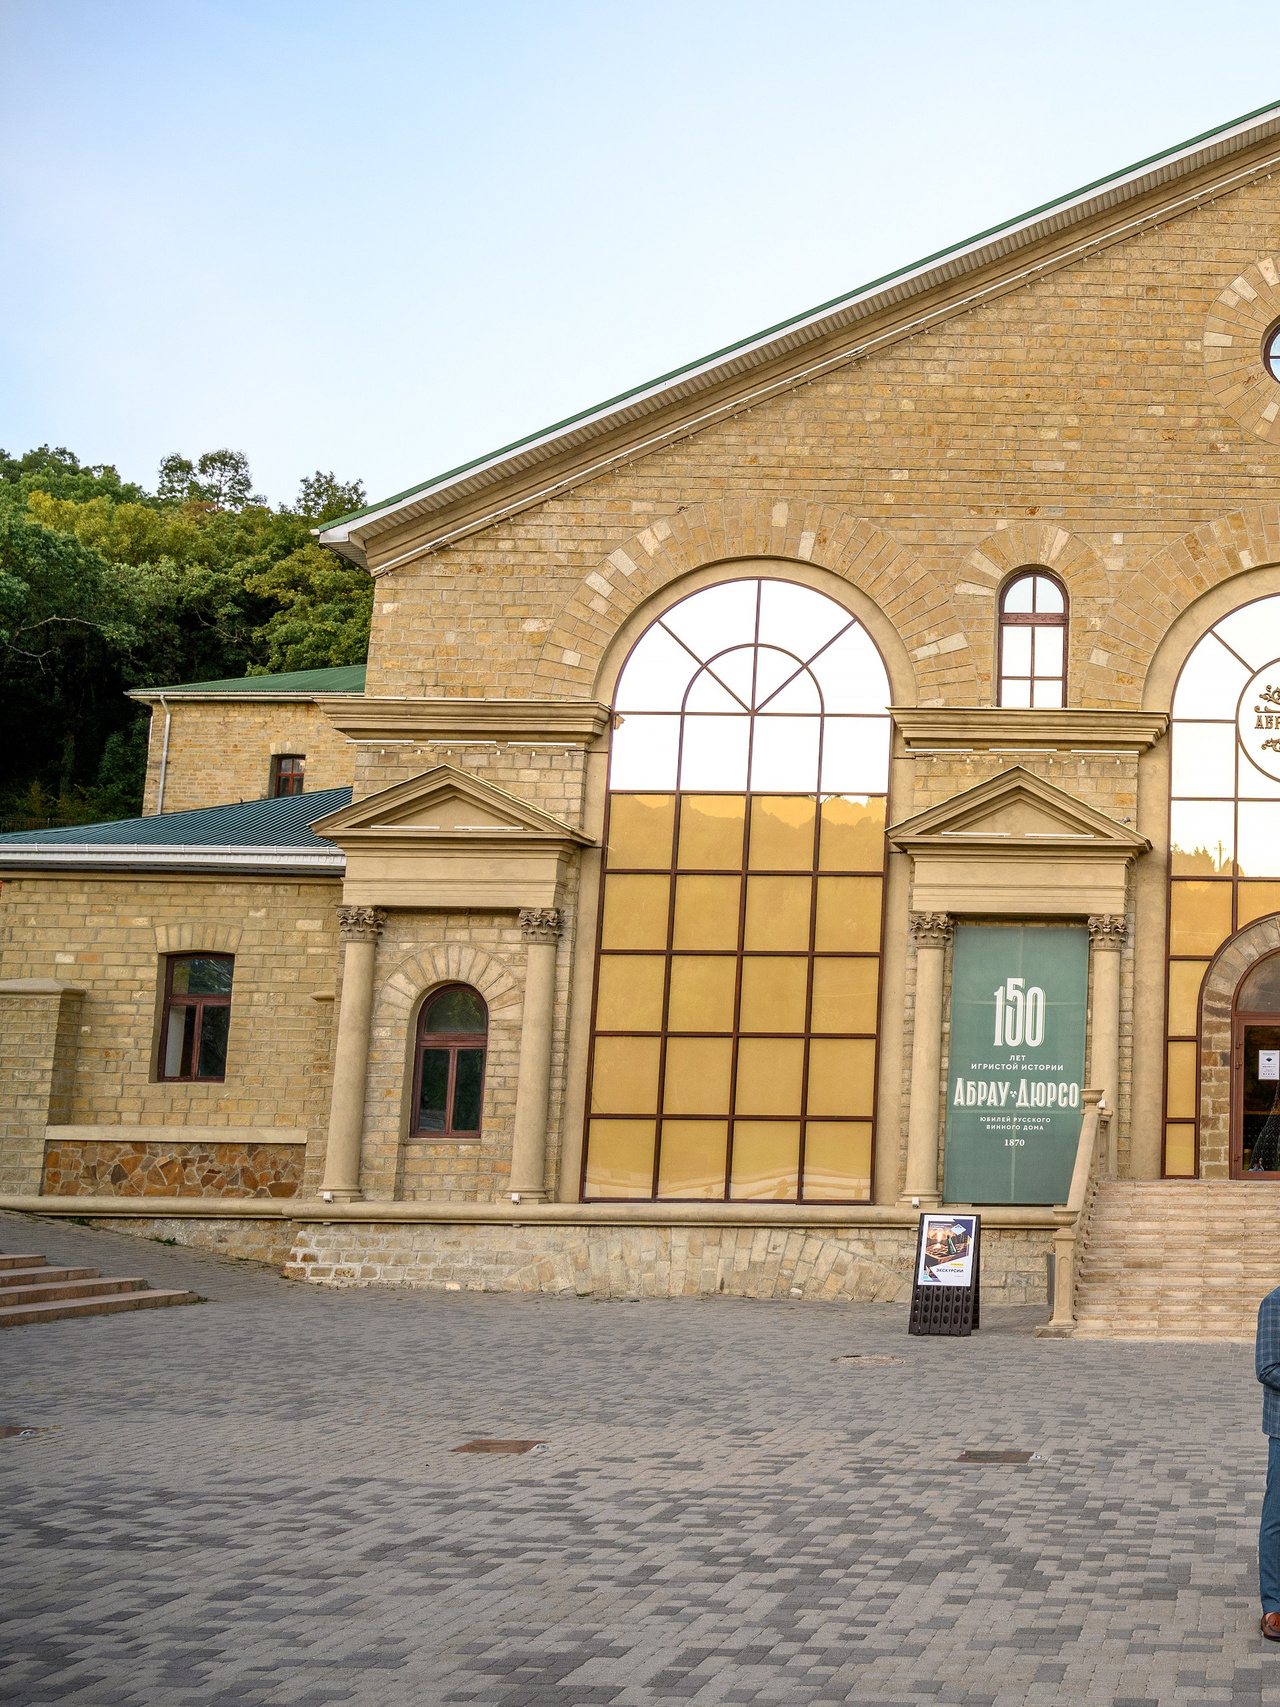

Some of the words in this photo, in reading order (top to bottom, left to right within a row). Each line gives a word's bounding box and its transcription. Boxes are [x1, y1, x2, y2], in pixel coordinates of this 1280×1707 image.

[993, 977, 1046, 1047] 150
[971, 1062, 1018, 1071] ИГРИСТОЙ
[980, 1115, 1011, 1123] ЮБИЛЕЙ
